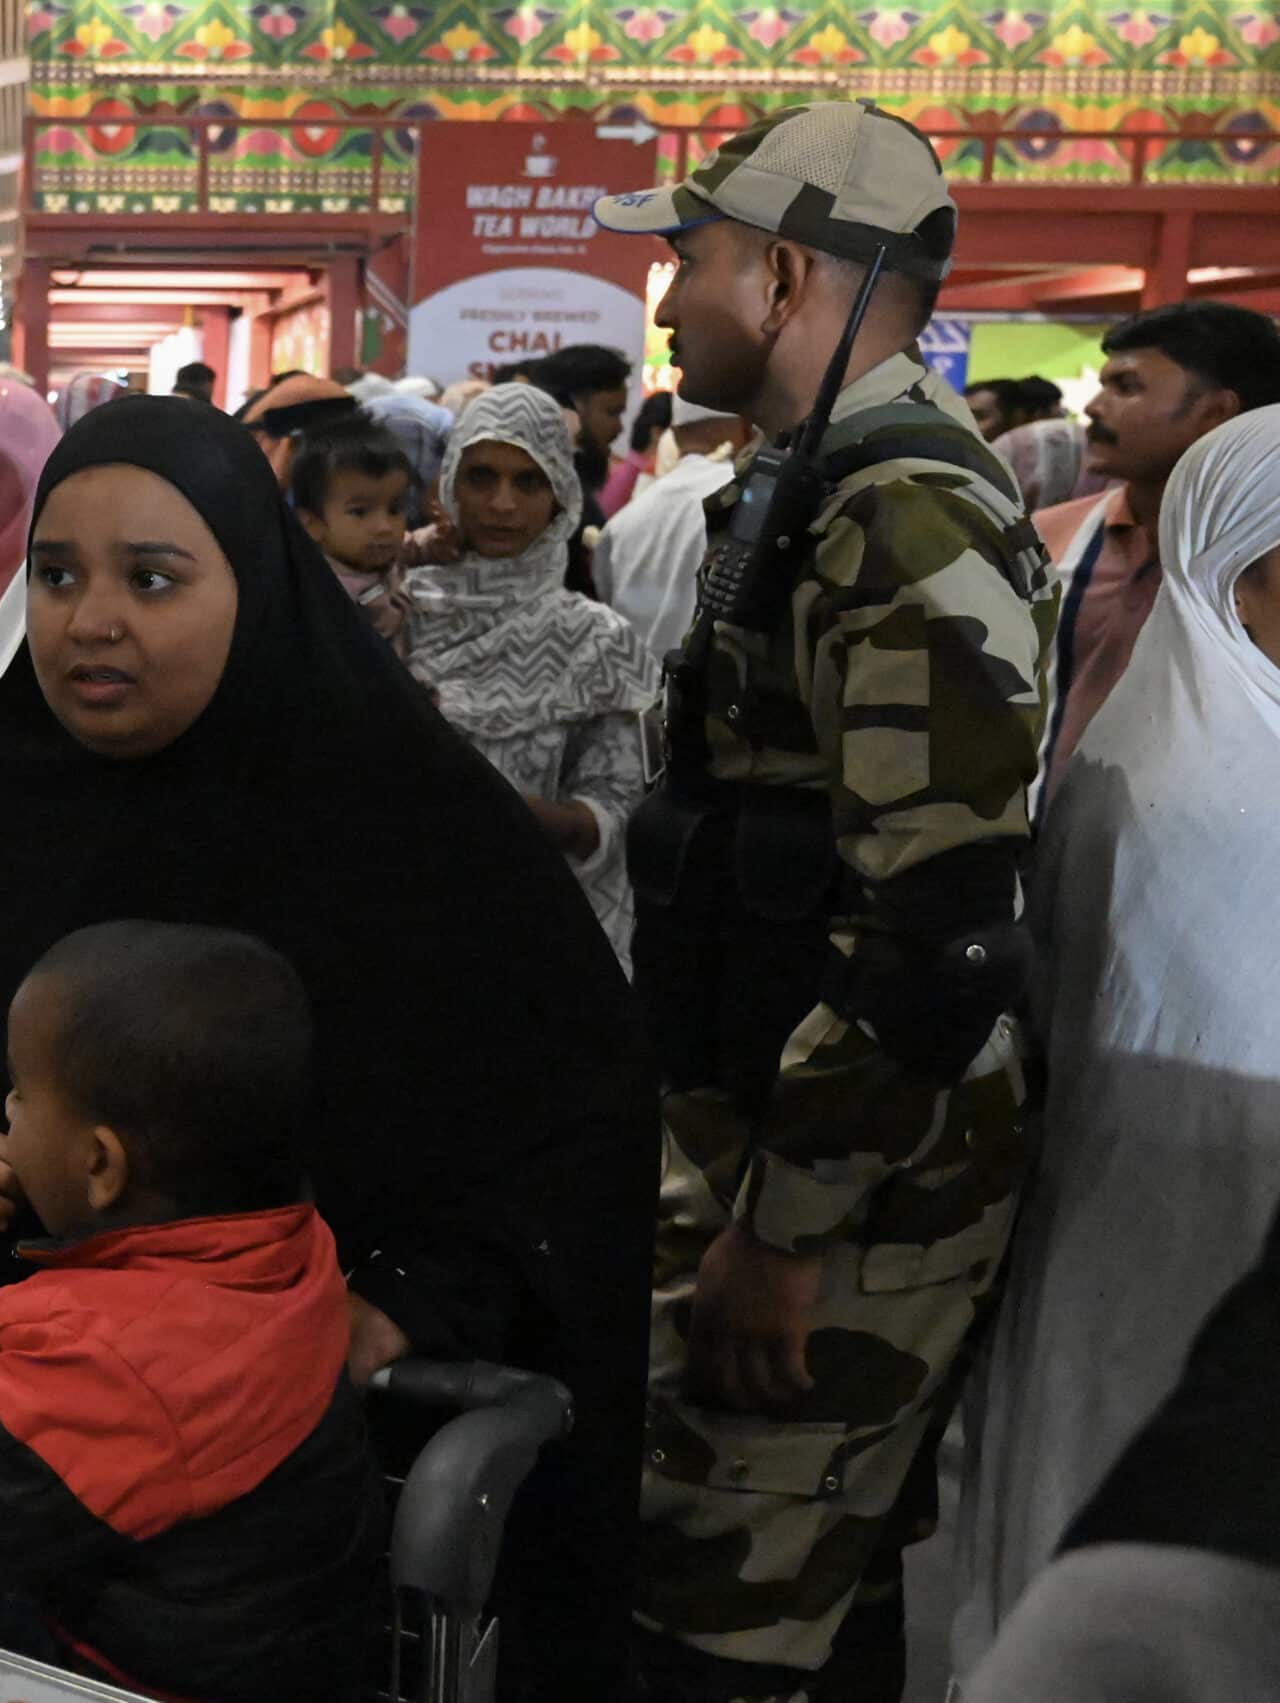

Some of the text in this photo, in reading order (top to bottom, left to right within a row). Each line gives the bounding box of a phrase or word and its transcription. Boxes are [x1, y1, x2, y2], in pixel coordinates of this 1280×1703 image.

[466, 185, 533, 209] WAGH
[472, 214, 600, 239] TEA WORLD
[488, 329, 563, 353] CHAI
